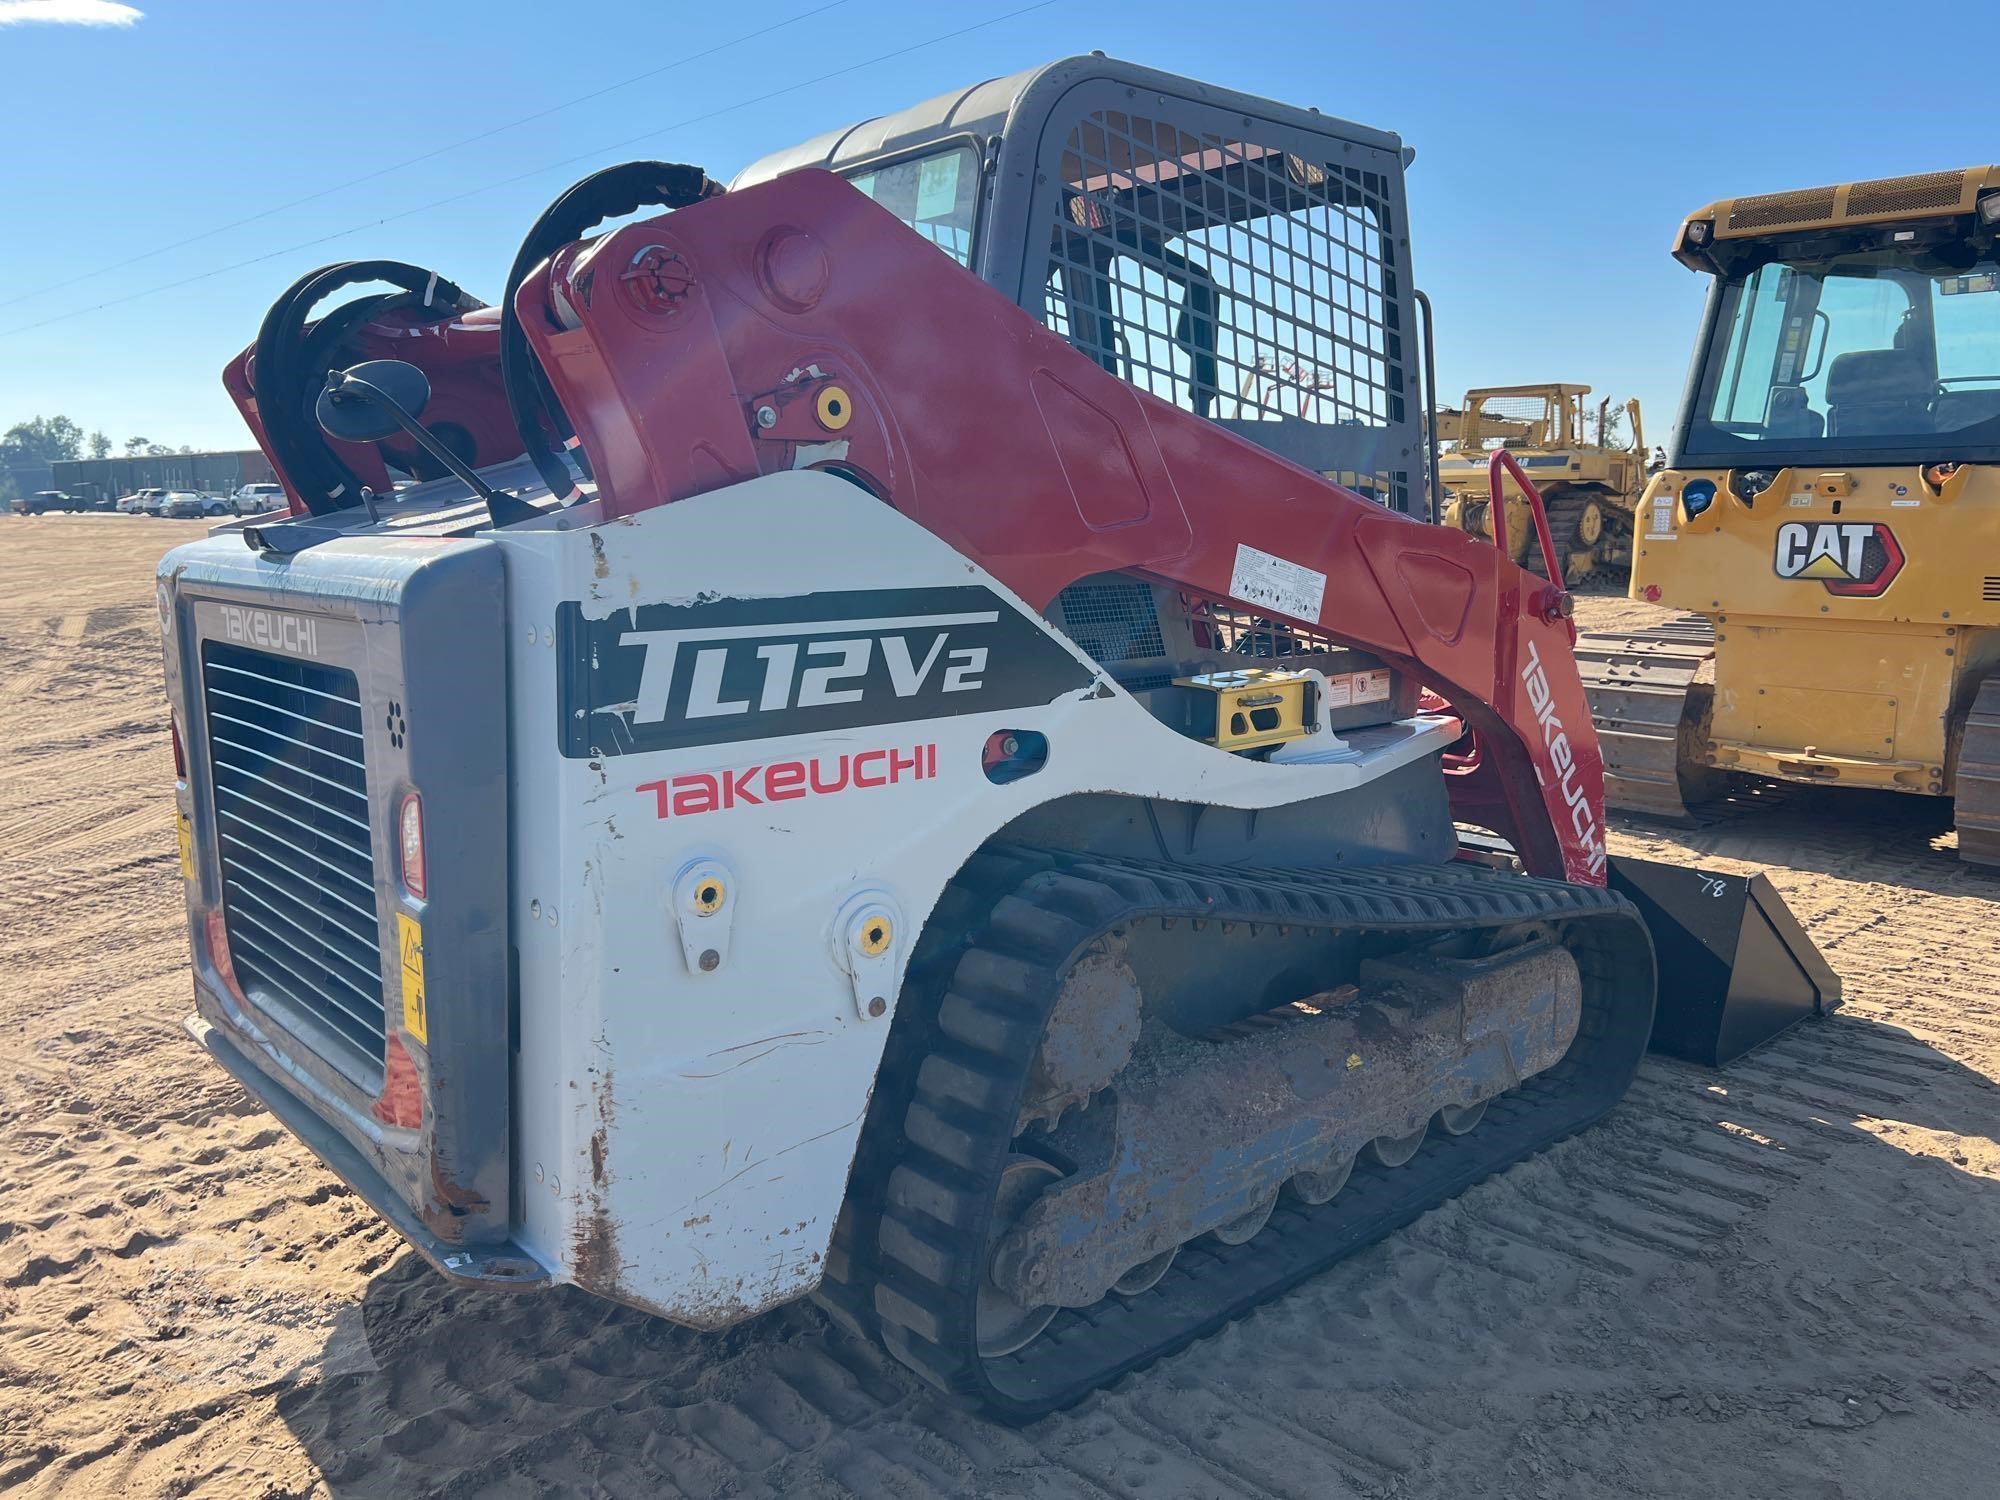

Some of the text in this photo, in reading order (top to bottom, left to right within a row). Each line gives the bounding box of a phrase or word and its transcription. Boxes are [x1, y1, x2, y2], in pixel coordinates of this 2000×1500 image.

[1776, 523, 1874, 579] CAT
[618, 611, 999, 724] TL12V2
[1696, 873, 1727, 897] 78
